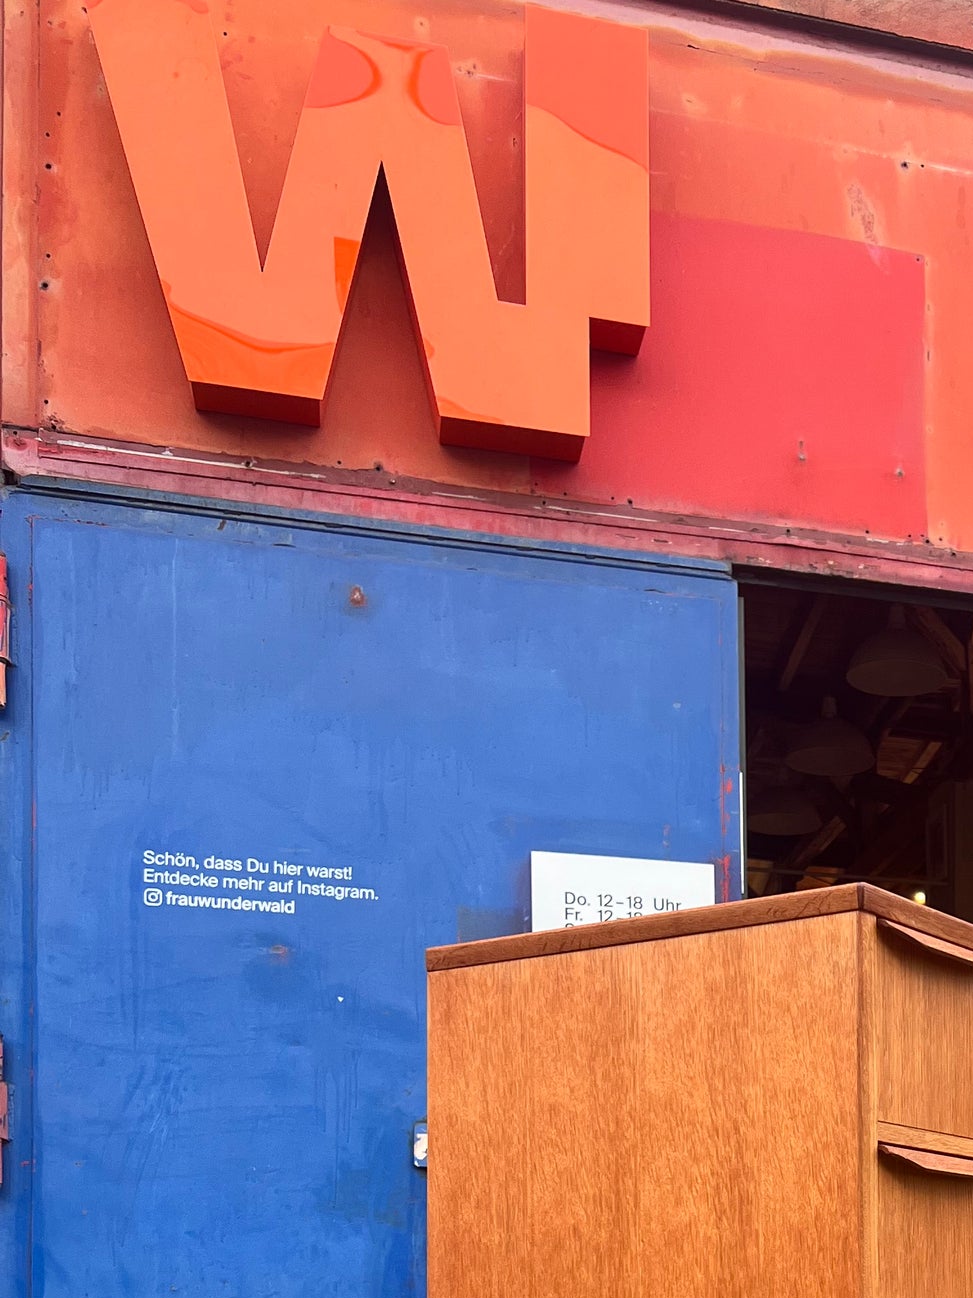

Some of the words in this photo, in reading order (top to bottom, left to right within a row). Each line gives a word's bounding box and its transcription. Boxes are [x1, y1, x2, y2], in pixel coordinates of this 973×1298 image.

[143, 850, 200, 870] Schön,
[203, 855, 243, 872] dass
[246, 858, 270, 874] Du
[273, 860, 304, 877] hier
[306, 865, 353, 881] warst!
[143, 868, 219, 888] Entdecke
[222, 876, 266, 892] mehr
[268, 879, 294, 894] auf
[297, 880, 380, 901] Instagram.
[165, 890, 296, 914] frauwunderwald
[564, 891, 591, 906] Do.
[653, 897, 682, 911] Uhr
[564, 907, 583, 921] Fr.
